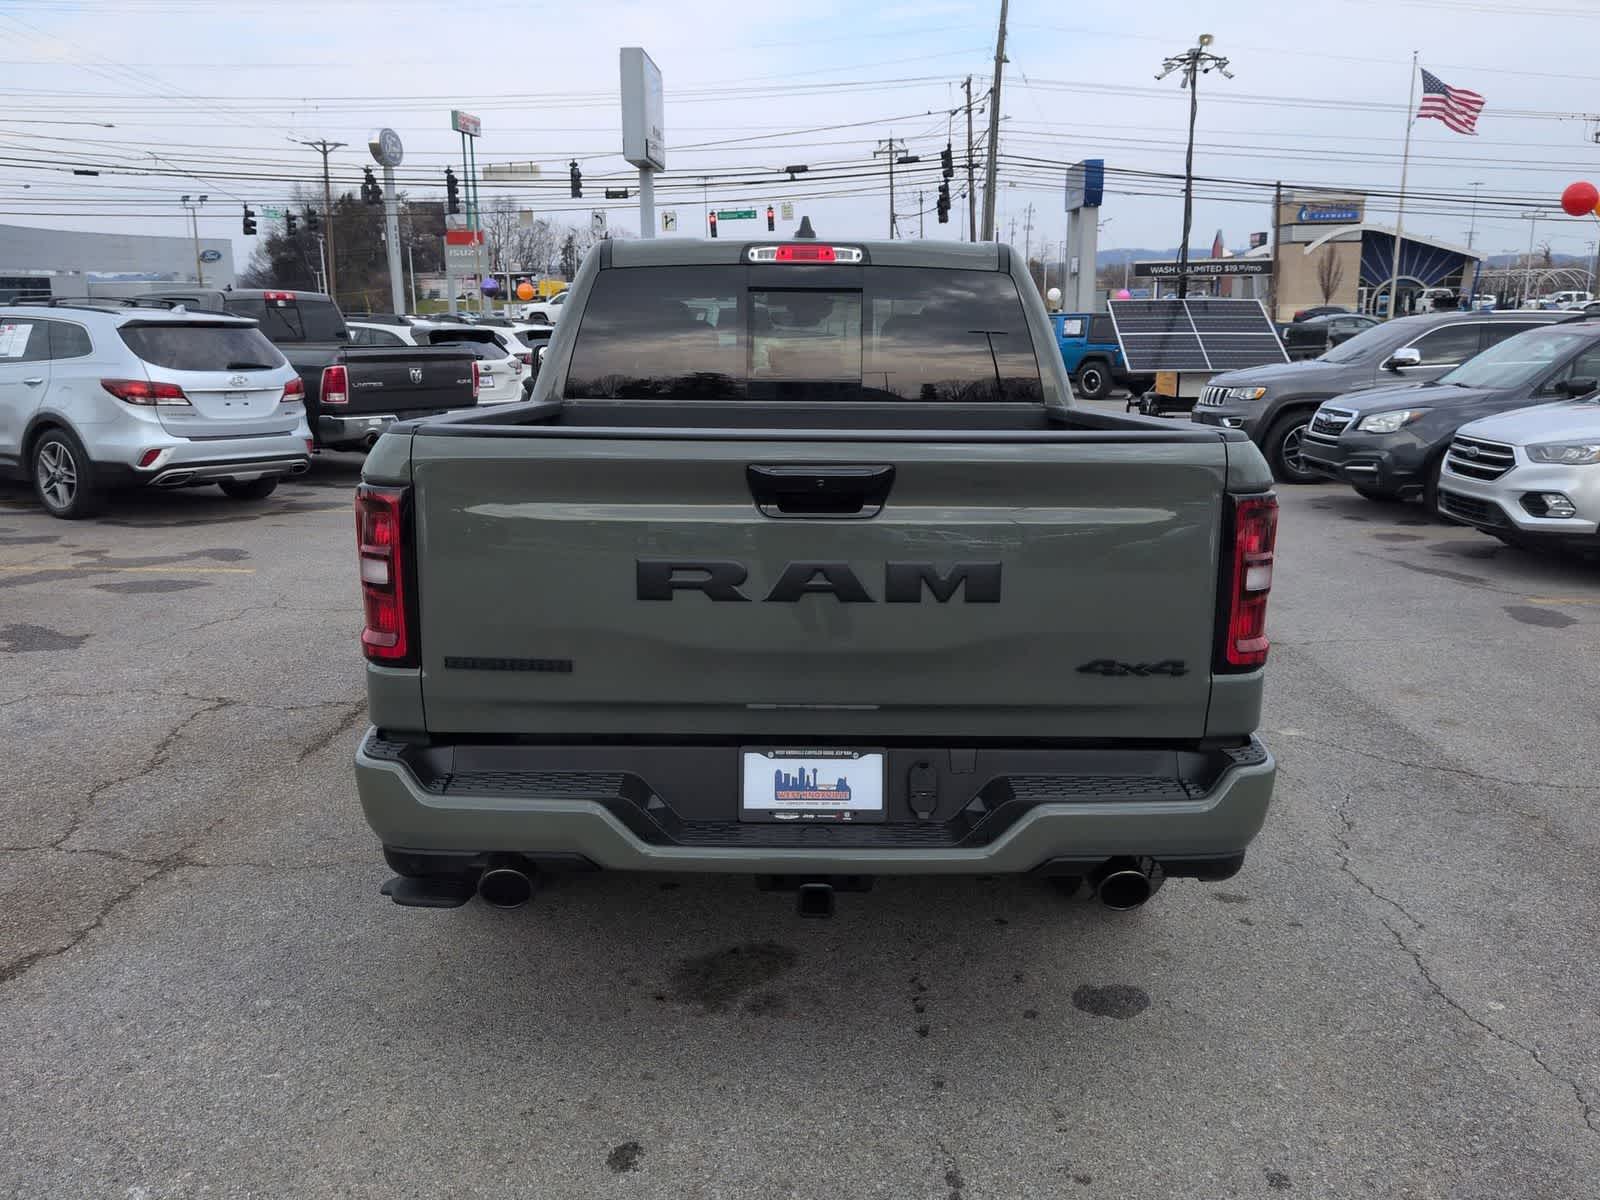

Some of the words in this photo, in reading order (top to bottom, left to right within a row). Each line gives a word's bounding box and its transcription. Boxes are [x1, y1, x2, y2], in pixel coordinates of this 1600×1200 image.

[1150, 265, 1176, 274] WASH
[636, 559, 1003, 603] RAM
[1075, 658, 1191, 677] 4x4
